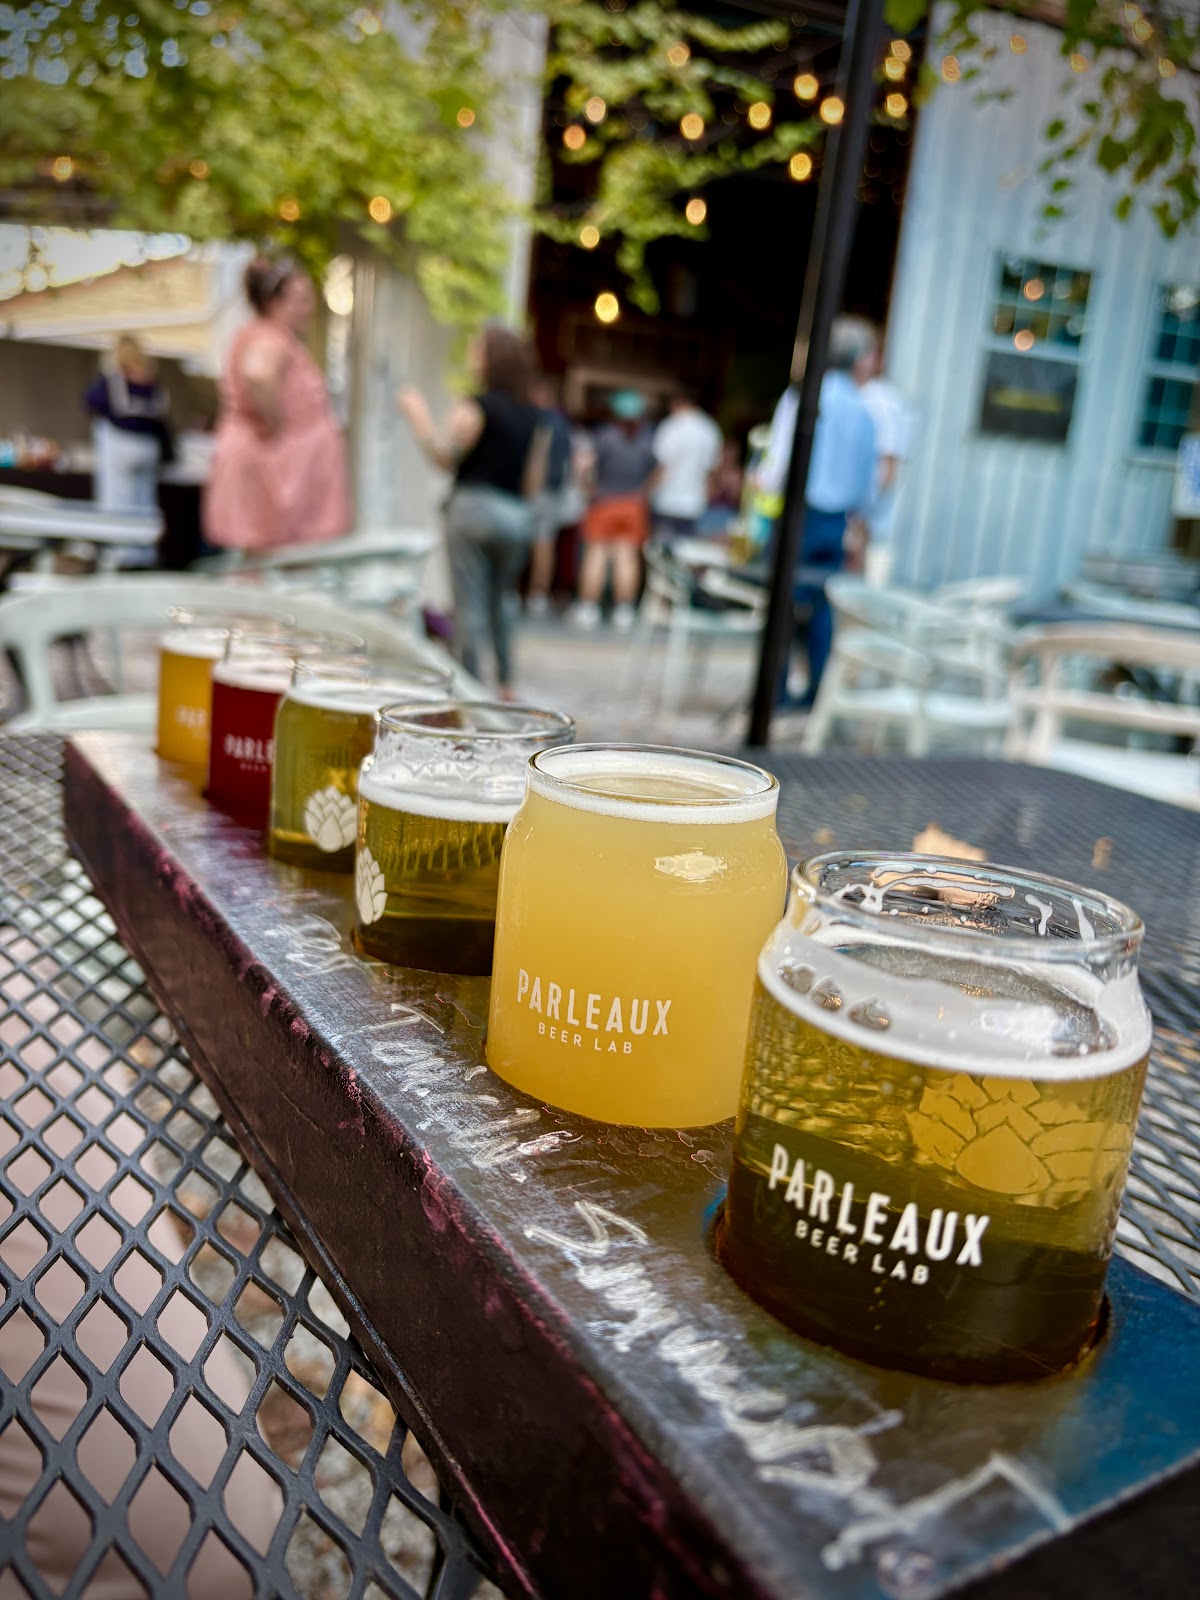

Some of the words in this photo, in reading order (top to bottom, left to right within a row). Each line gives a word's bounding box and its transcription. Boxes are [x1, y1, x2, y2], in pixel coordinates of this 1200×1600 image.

[517, 968, 672, 1036] PARLEAUX
[538, 1022, 582, 1047] BEER
[594, 1038, 633, 1054] LAB
[768, 1143, 991, 1267] PARLEAUX
[794, 1219, 860, 1265] BEER
[871, 1253, 930, 1286] LAB
